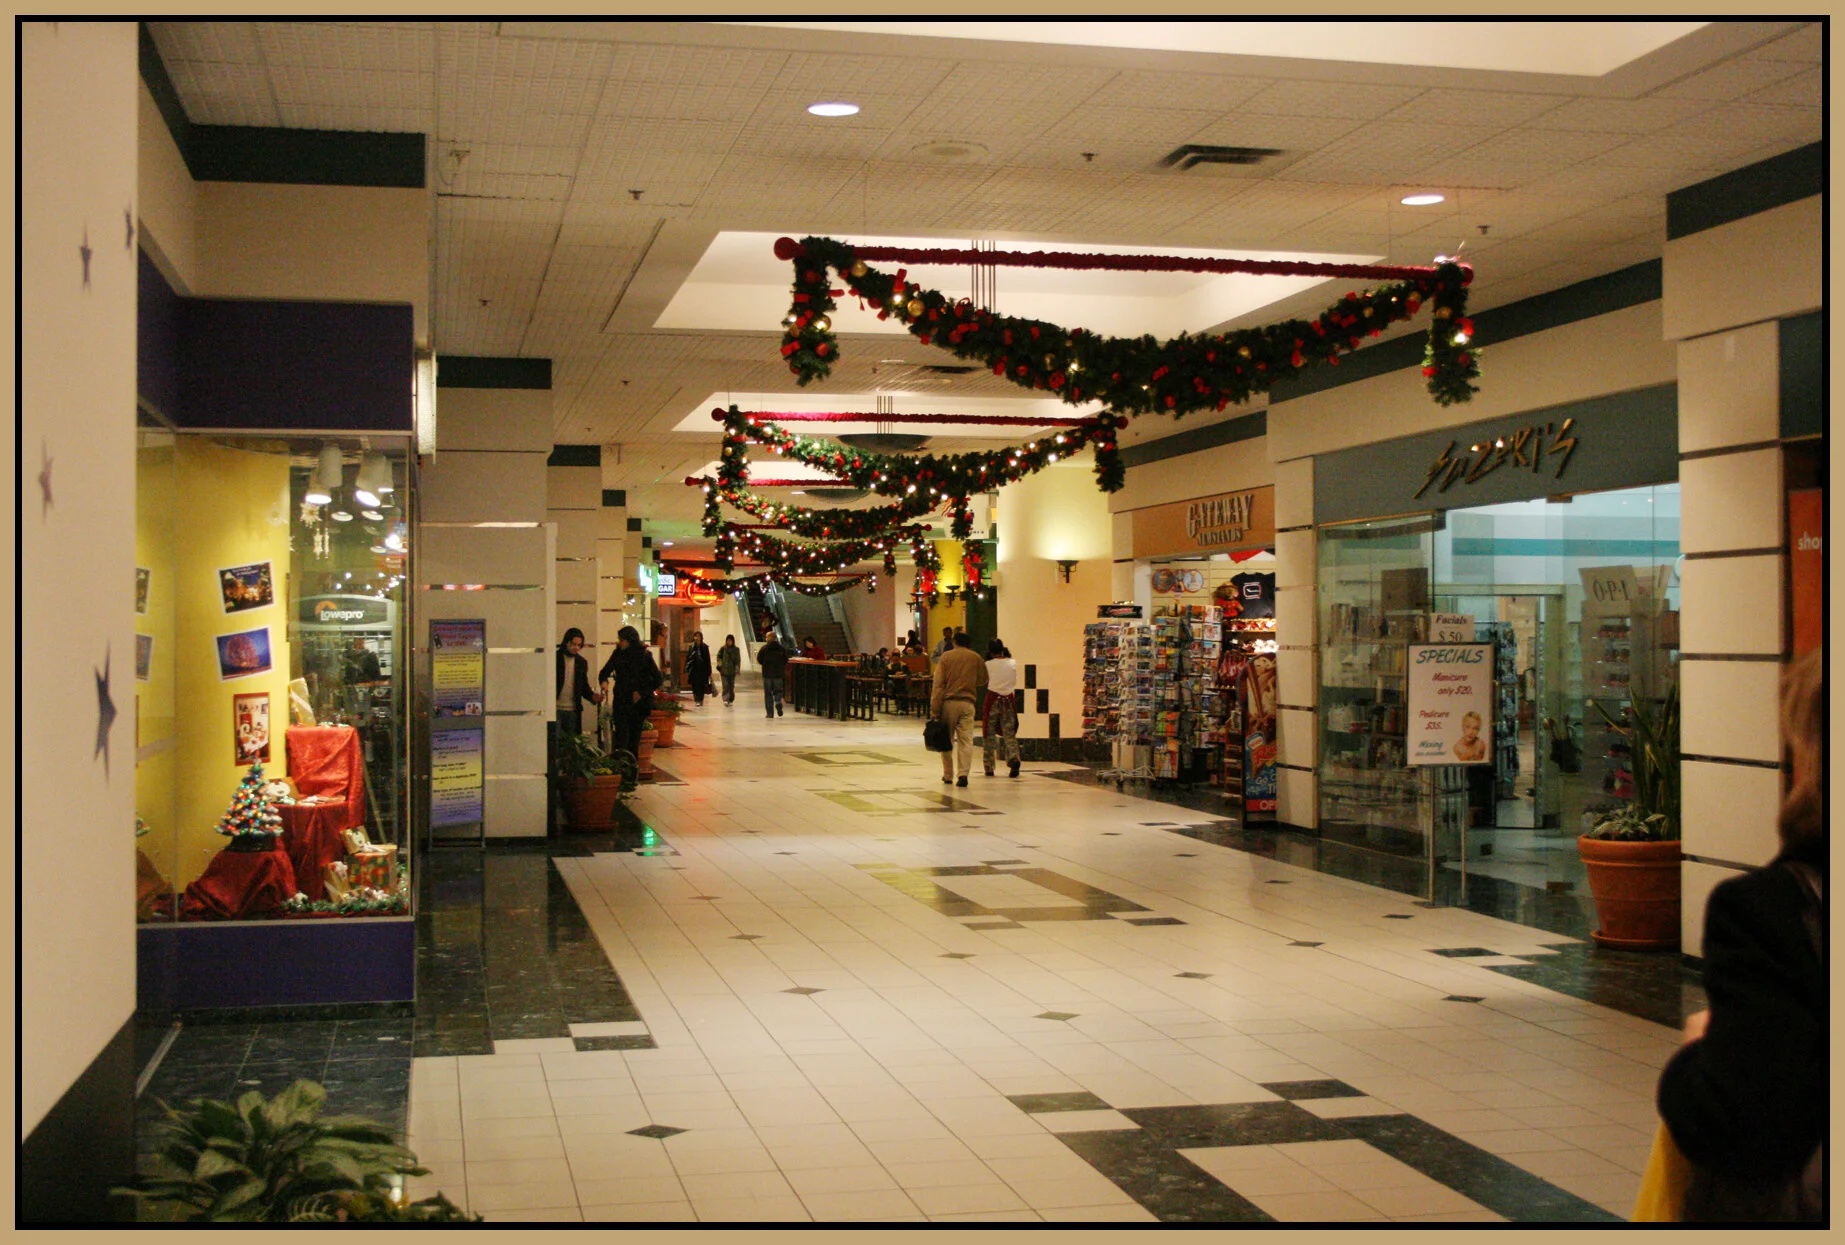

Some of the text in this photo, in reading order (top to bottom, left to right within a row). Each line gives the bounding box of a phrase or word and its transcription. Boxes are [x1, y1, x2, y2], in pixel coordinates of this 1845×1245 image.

[1186, 494, 1254, 538] GATEWAY
[1797, 531, 1823, 555] sho
[1435, 614, 1467, 625] Facials
[1416, 648, 1484, 664] SPECIALS
[1431, 672, 1469, 682] Manicure
[1437, 686, 1453, 696] only
[1418, 709, 1450, 719] Pedicure
